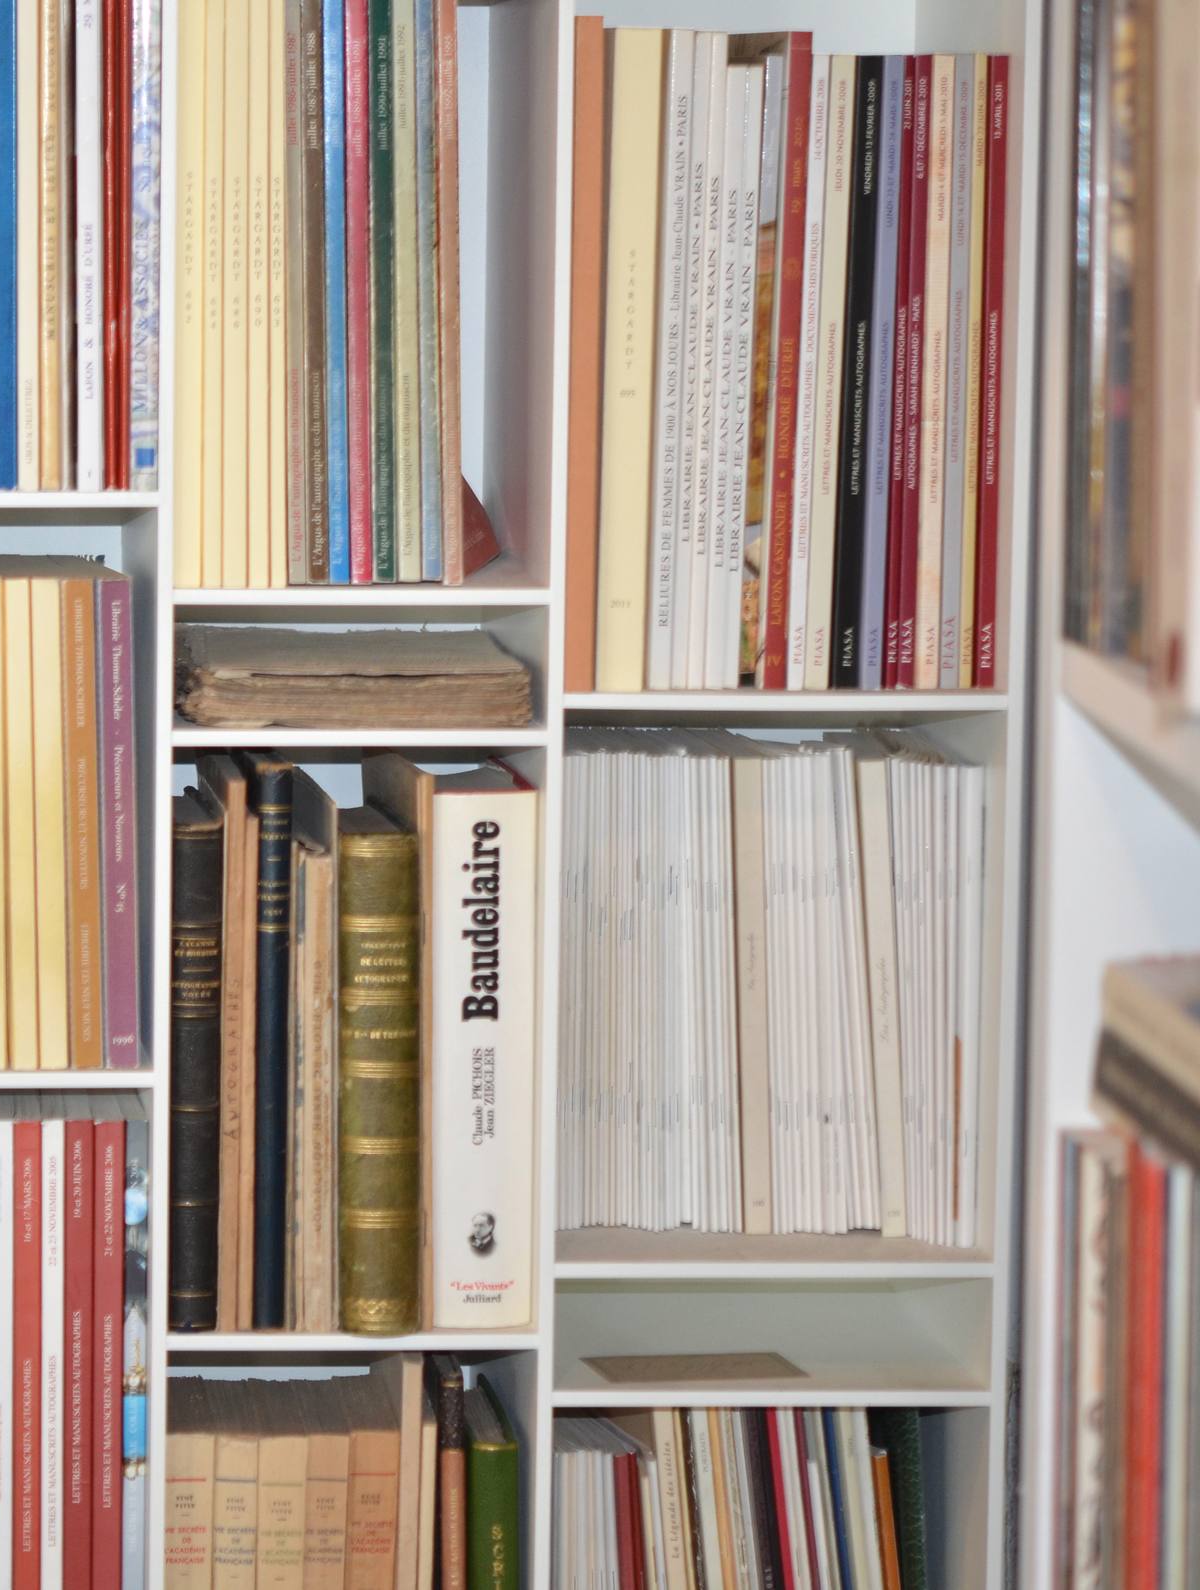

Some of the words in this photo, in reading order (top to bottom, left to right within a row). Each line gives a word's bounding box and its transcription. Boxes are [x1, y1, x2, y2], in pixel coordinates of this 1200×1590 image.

[866, 80, 877, 102] 2009
[306, 119, 318, 149] juillet
[675, 94, 688, 137] PARIS
[673, 150, 686, 192] VRAIN
[692, 162, 704, 217] PARIS
[862, 151, 874, 195] VENDREDI
[915, 162, 925, 172] ET
[707, 176, 720, 231] PARIS
[741, 190, 754, 247] PARIS
[254, 176, 263, 280] STARGARDT
[272, 176, 281, 281] STARGARDT
[671, 196, 685, 261] Jean-Claude
[669, 264, 682, 311] Librairie
[689, 236, 702, 298] VRAIN
[704, 248, 718, 311] VRAIN
[625, 248, 636, 370] STARGARDT
[738, 265, 752, 327] VRAIN
[911, 296, 921, 322] PAPES
[84, 338, 94, 348] &
[667, 324, 680, 366] JOURS
[855, 322, 867, 387] AUTOGRAPHES
[909, 332, 920, 384] BERNHARDT
[84, 361, 94, 399] LAFON
[132, 336, 148, 412] MILLON
[666, 370, 678, 396] NOS
[852, 390, 864, 446] MANUSCRITS
[909, 387, 919, 416] SARAH
[310, 421, 321, 434] du
[664, 415, 677, 440] 1900
[776, 396, 790, 460] HONORÉ
[663, 444, 676, 464] DE
[852, 448, 862, 458] ET
[906, 426, 918, 490] AUTOGRAPHES
[661, 468, 675, 527] FEMMES
[681, 446, 695, 543] LIBRAIRIE
[850, 460, 861, 496] LETTRES
[311, 512, 323, 524] de
[695, 460, 711, 556] LIBRAIRIE
[728, 476, 744, 572] LIBRAIRIE
[660, 531, 672, 551] DE
[772, 490, 787, 575] CASTANDET
[657, 556, 672, 628] RELIURES
[770, 579, 784, 625] LAFON
[110, 600, 122, 642] Librairie
[901, 618, 913, 664] PIASA
[842, 626, 854, 667] PIASA
[980, 623, 992, 669] PIASA
[114, 814, 126, 862] Novateurs
[460, 820, 500, 1022] Baudelaire
[113, 1034, 135, 1046] 1996
[470, 1048, 484, 1100] PICHOIS
[483, 1047, 496, 1106] ZIEGLER
[470, 1106, 484, 1146] Claude
[483, 1110, 496, 1139] Jean
[72, 1163, 82, 1185] JUIN
[463, 1294, 501, 1304] Julliard
[72, 1311, 82, 1381] AUTOGRAPHES
[72, 1383, 82, 1446] MANUSCRITS
[72, 1448, 82, 1460] ET
[72, 1462, 82, 1504] LETTRES
